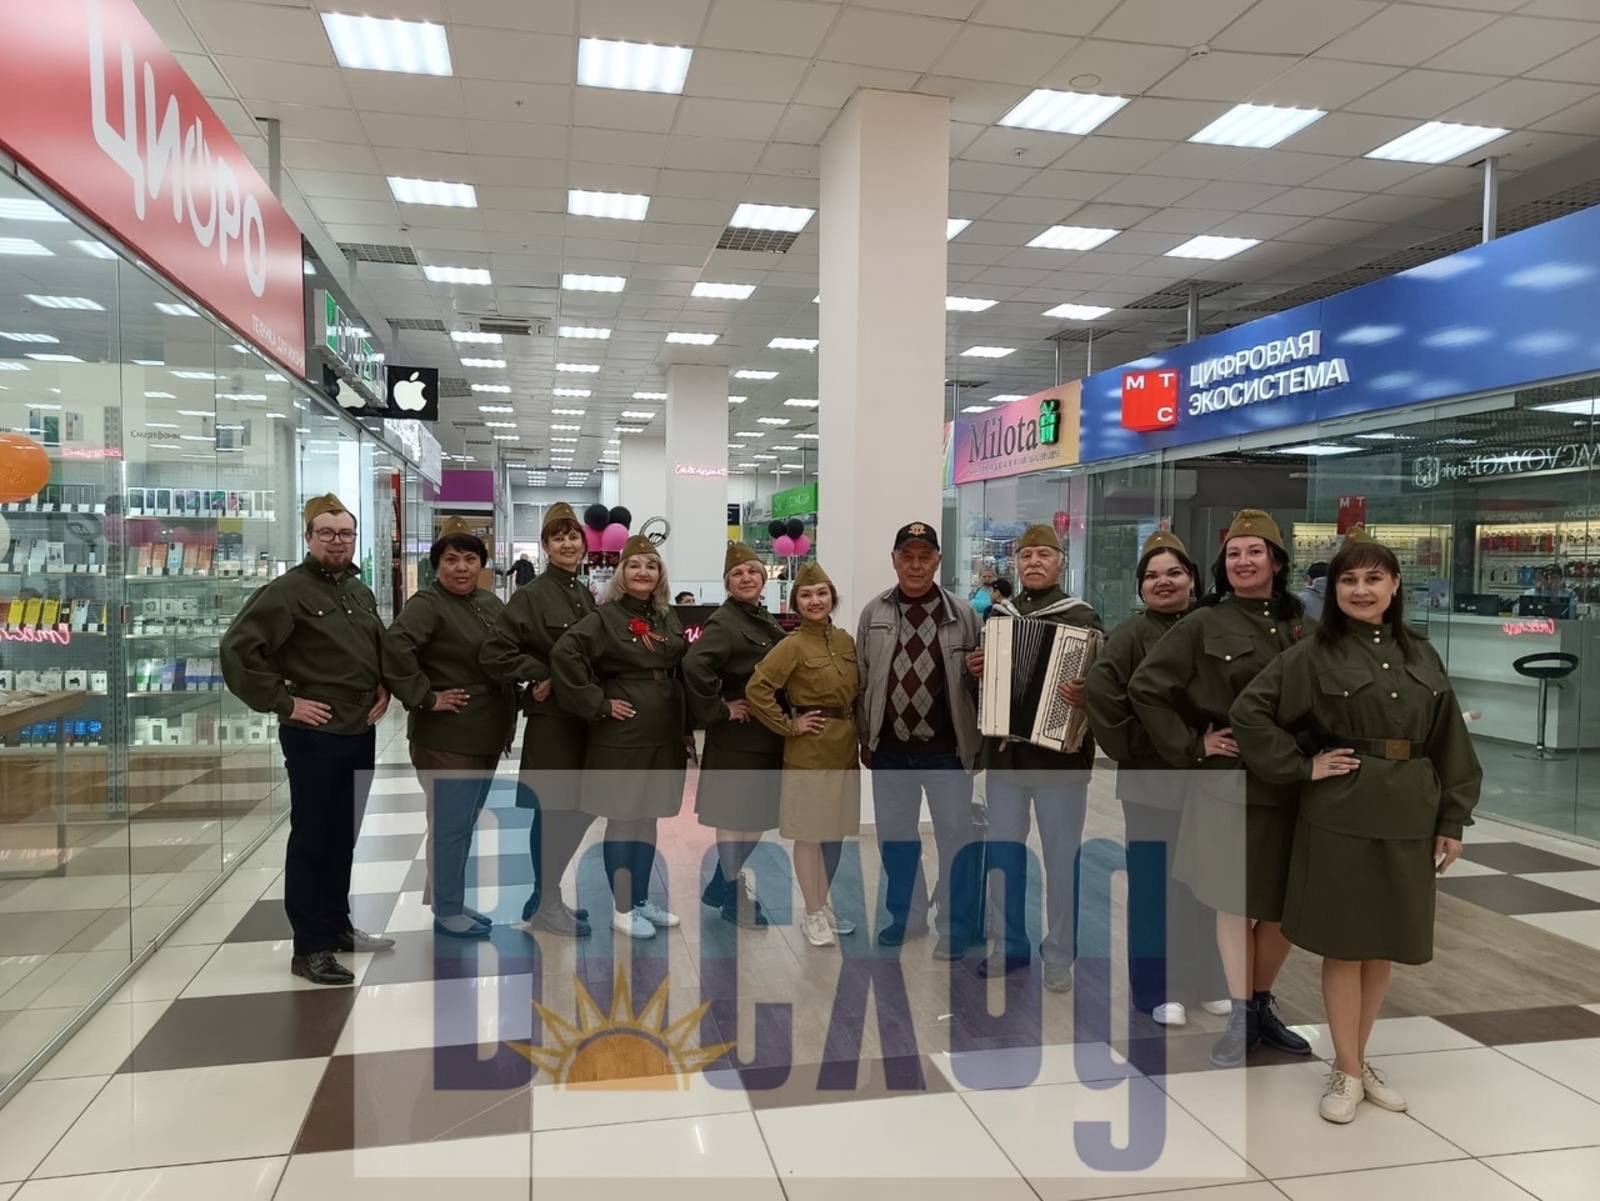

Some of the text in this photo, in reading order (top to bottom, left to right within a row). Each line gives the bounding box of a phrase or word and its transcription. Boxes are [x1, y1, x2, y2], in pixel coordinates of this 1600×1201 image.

[1188, 358, 1349, 416] ЭКОСИСТЕМА
[1189, 330, 1321, 389] ЦИФРОВАЯ
[967, 412, 1039, 464] Milota
